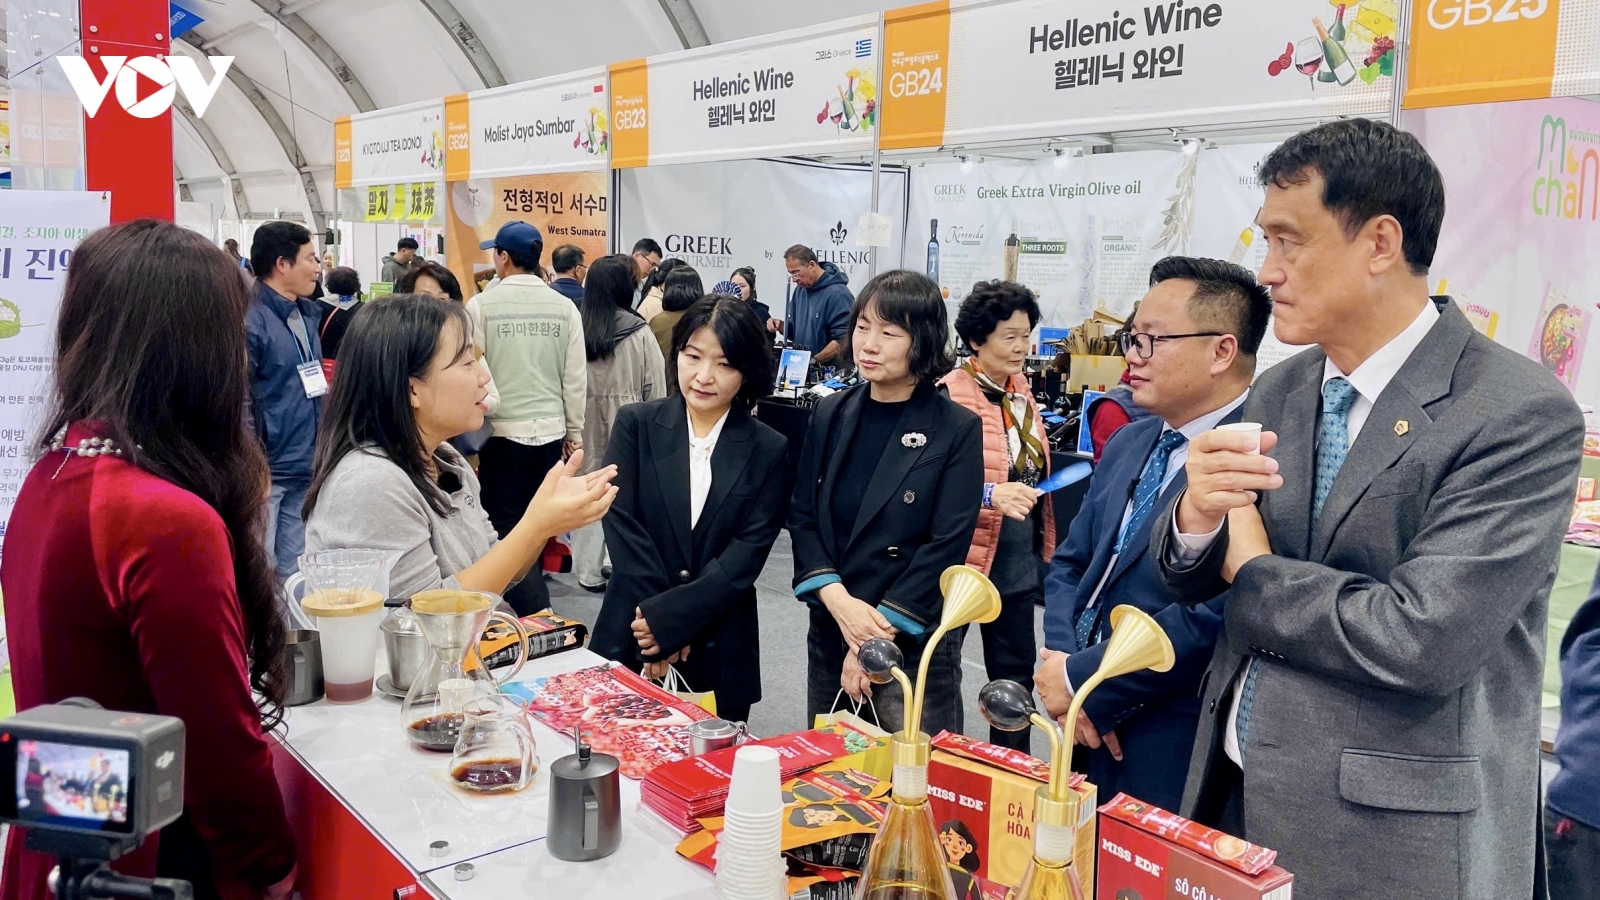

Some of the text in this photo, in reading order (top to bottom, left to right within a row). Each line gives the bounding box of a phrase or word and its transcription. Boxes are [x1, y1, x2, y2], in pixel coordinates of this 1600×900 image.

[1029, 0, 1223, 54] Hellenic Wine
[815, 50, 832, 60] 그리스
[1055, 44, 1184, 90] 헬레닉 와인
[693, 67, 794, 101] Hellenic Wine
[889, 66, 943, 98] GB24
[614, 107, 646, 130] GB23
[707, 98, 776, 128] 헬레닉 와인
[484, 124, 510, 143] Molist
[511, 123, 534, 142] Jaya
[536, 116, 575, 135] Sumbar
[362, 142, 380, 155] KYOTO
[391, 139, 402, 152] TEA
[447, 133, 469, 150] GB22
[934, 184, 966, 196] GREEK
[977, 180, 1142, 199] Greek Extra Virgin Olive oil
[368, 190, 389, 216] 말차
[503, 188, 564, 214] 전형적인
[547, 225, 607, 237] West Sumatra
[665, 234, 733, 255] GREEK
[1021, 244, 1065, 252] THREE ROOTS
[1104, 244, 1138, 252] ORGANIC
[665, 254, 733, 268] GOURMET
[765, 250, 774, 260] by
[811, 248, 871, 264] ELLENIC
[497, 322, 561, 338] (주)마한환경
[8, 395, 24, 405] 만든
[2, 429, 25, 441] 예방
[927, 784, 985, 812] MISS EDE
[1007, 802, 1024, 820] CÀ
[1006, 820, 1031, 840] HÒA
[1102, 838, 1160, 877] MISS EDE
[1175, 877, 1190, 896] SÔ
